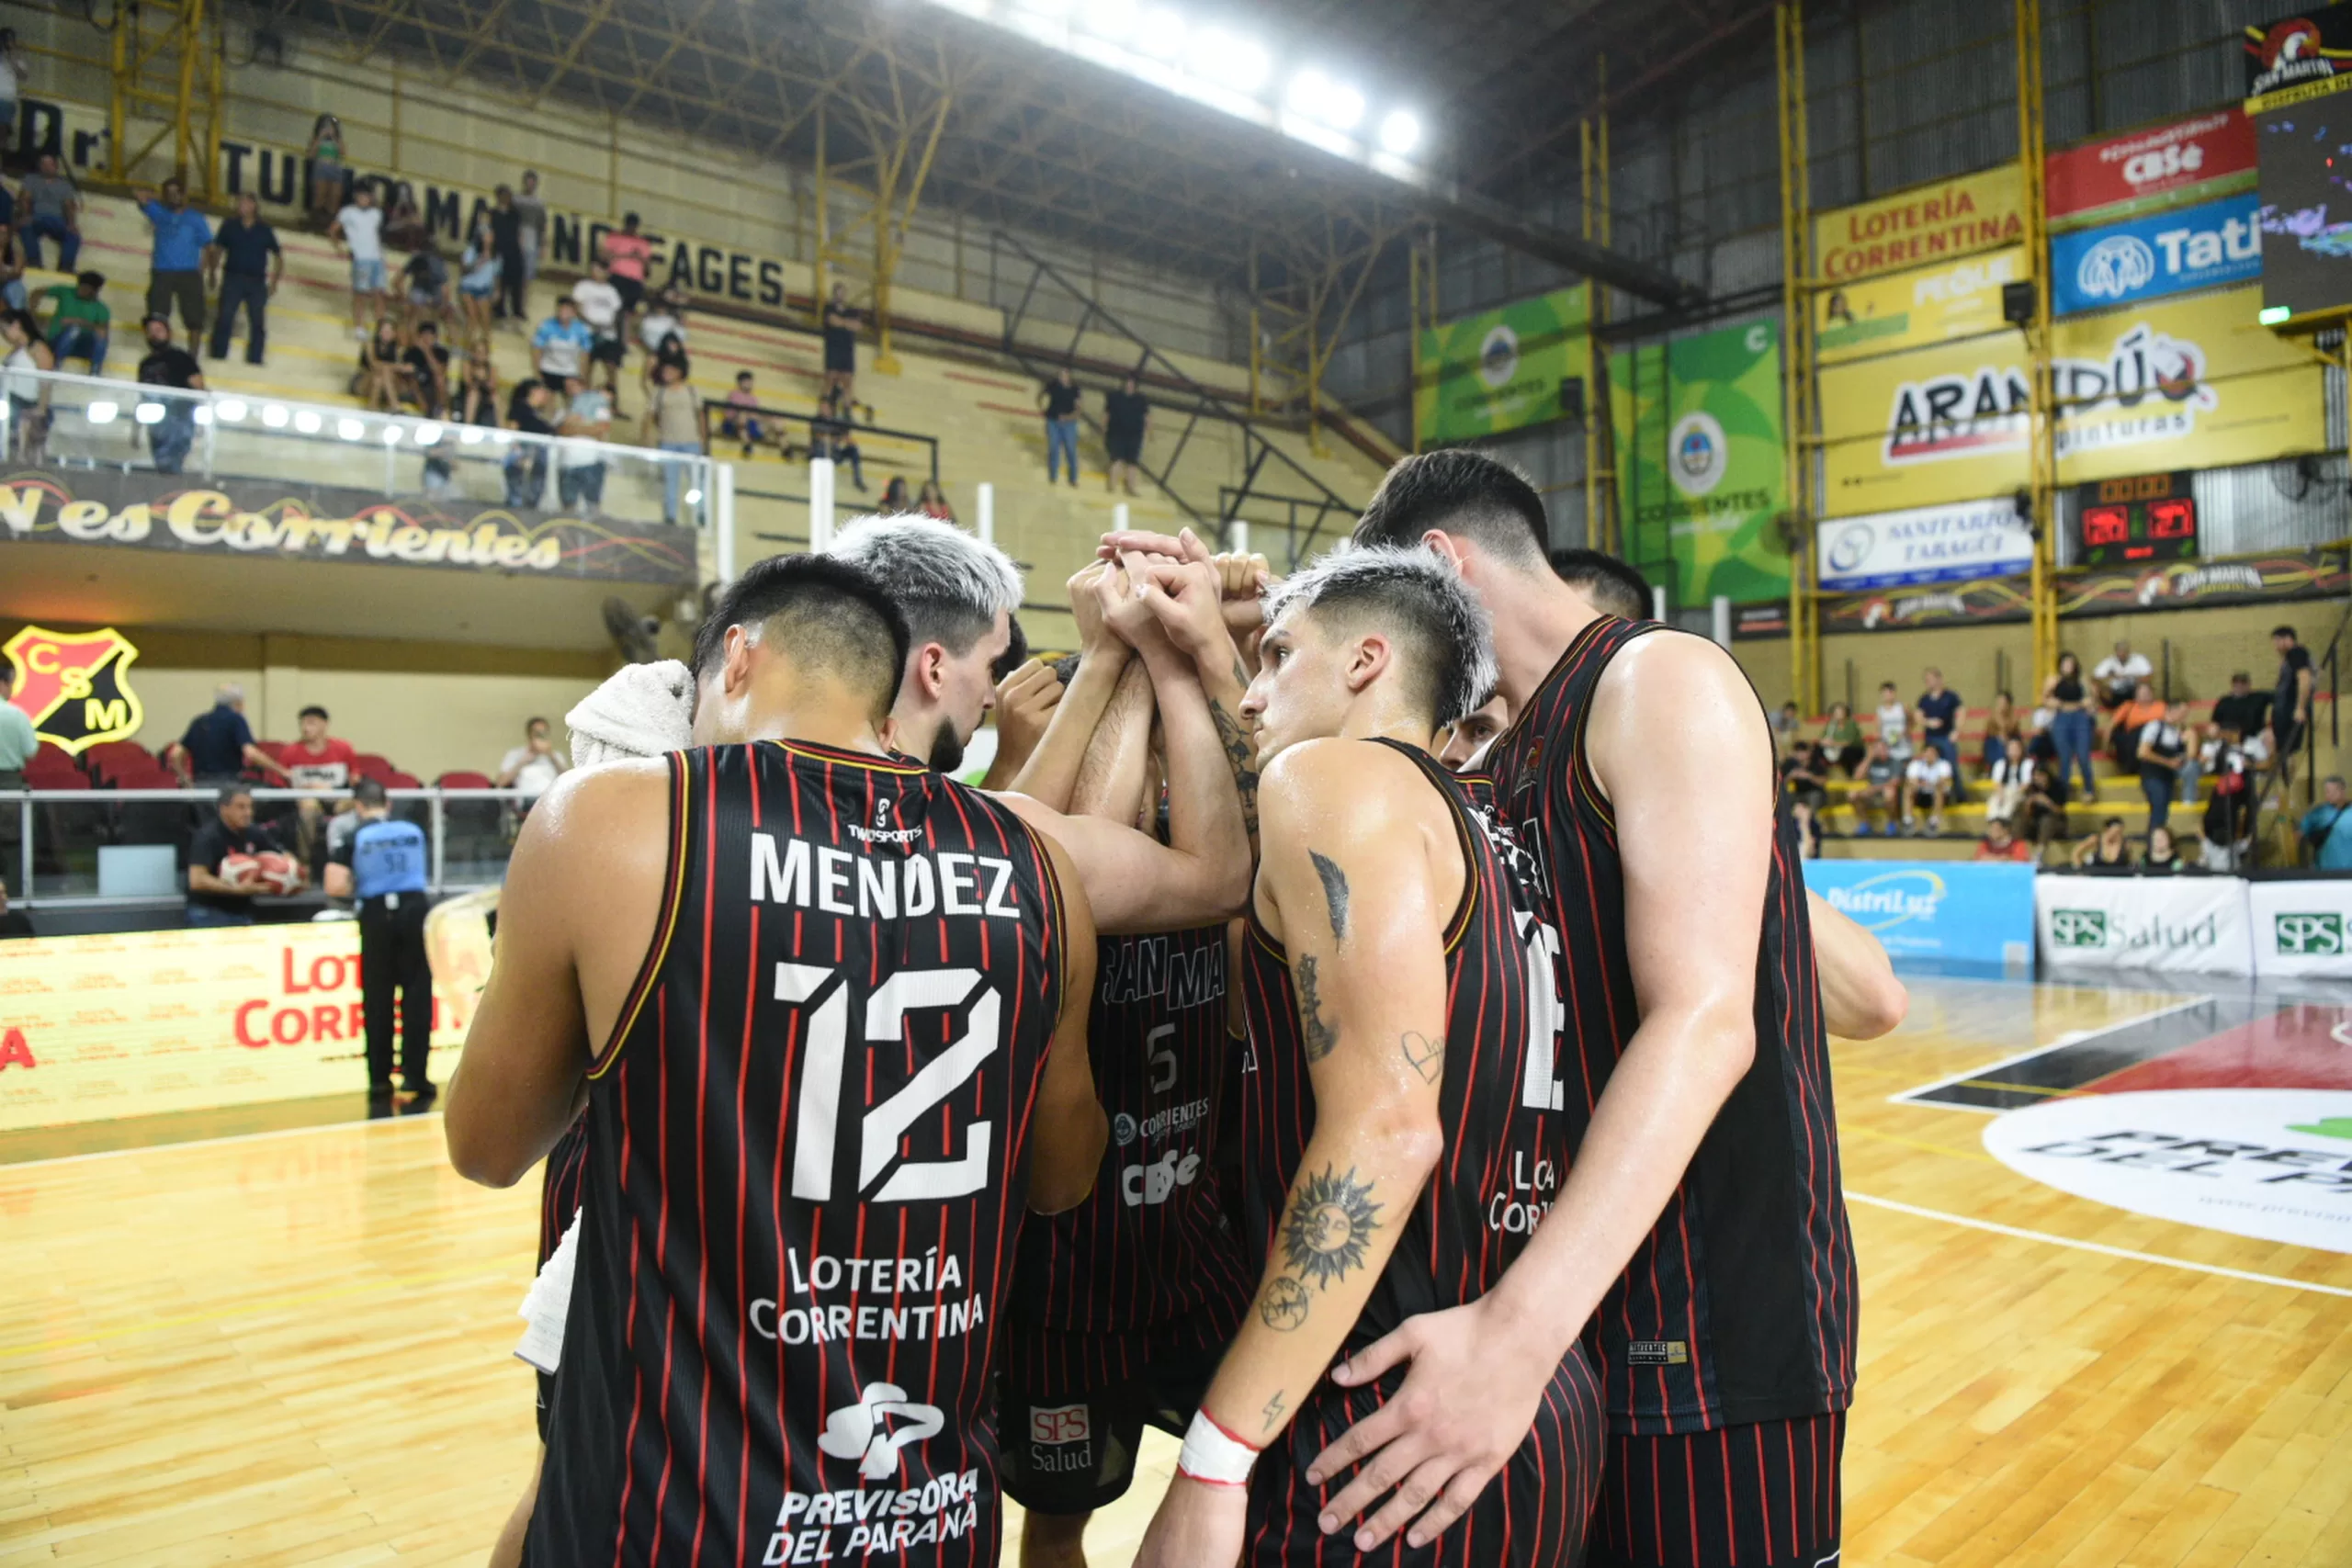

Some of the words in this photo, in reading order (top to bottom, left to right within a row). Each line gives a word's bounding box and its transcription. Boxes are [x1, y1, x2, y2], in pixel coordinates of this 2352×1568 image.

[1849, 189, 1974, 243] LOTERÍA
[1825, 212, 2021, 279] CORRENTINA
[58, 500, 151, 542] es
[167, 489, 560, 570] Corrientes
[847, 823, 922, 844] TWOSPORTS
[750, 832, 1021, 919] MENDEZ
[2053, 910, 2106, 946] SPS
[2110, 913, 2215, 950] Salud
[2277, 916, 2341, 953] SPS
[284, 947, 365, 994] LOT
[774, 961, 1001, 1202] 12
[1147, 1022, 1177, 1094] 5
[787, 1247, 962, 1294] LOTERÍA
[749, 1293, 984, 1345] CORRENTINA
[1034, 1407, 1087, 1441] SPS
[1031, 1440, 1092, 1472] Salud
[776, 1468, 978, 1527] PREVISORA
[762, 1531, 834, 1566] DEL
[842, 1495, 978, 1559] PARANÁ
